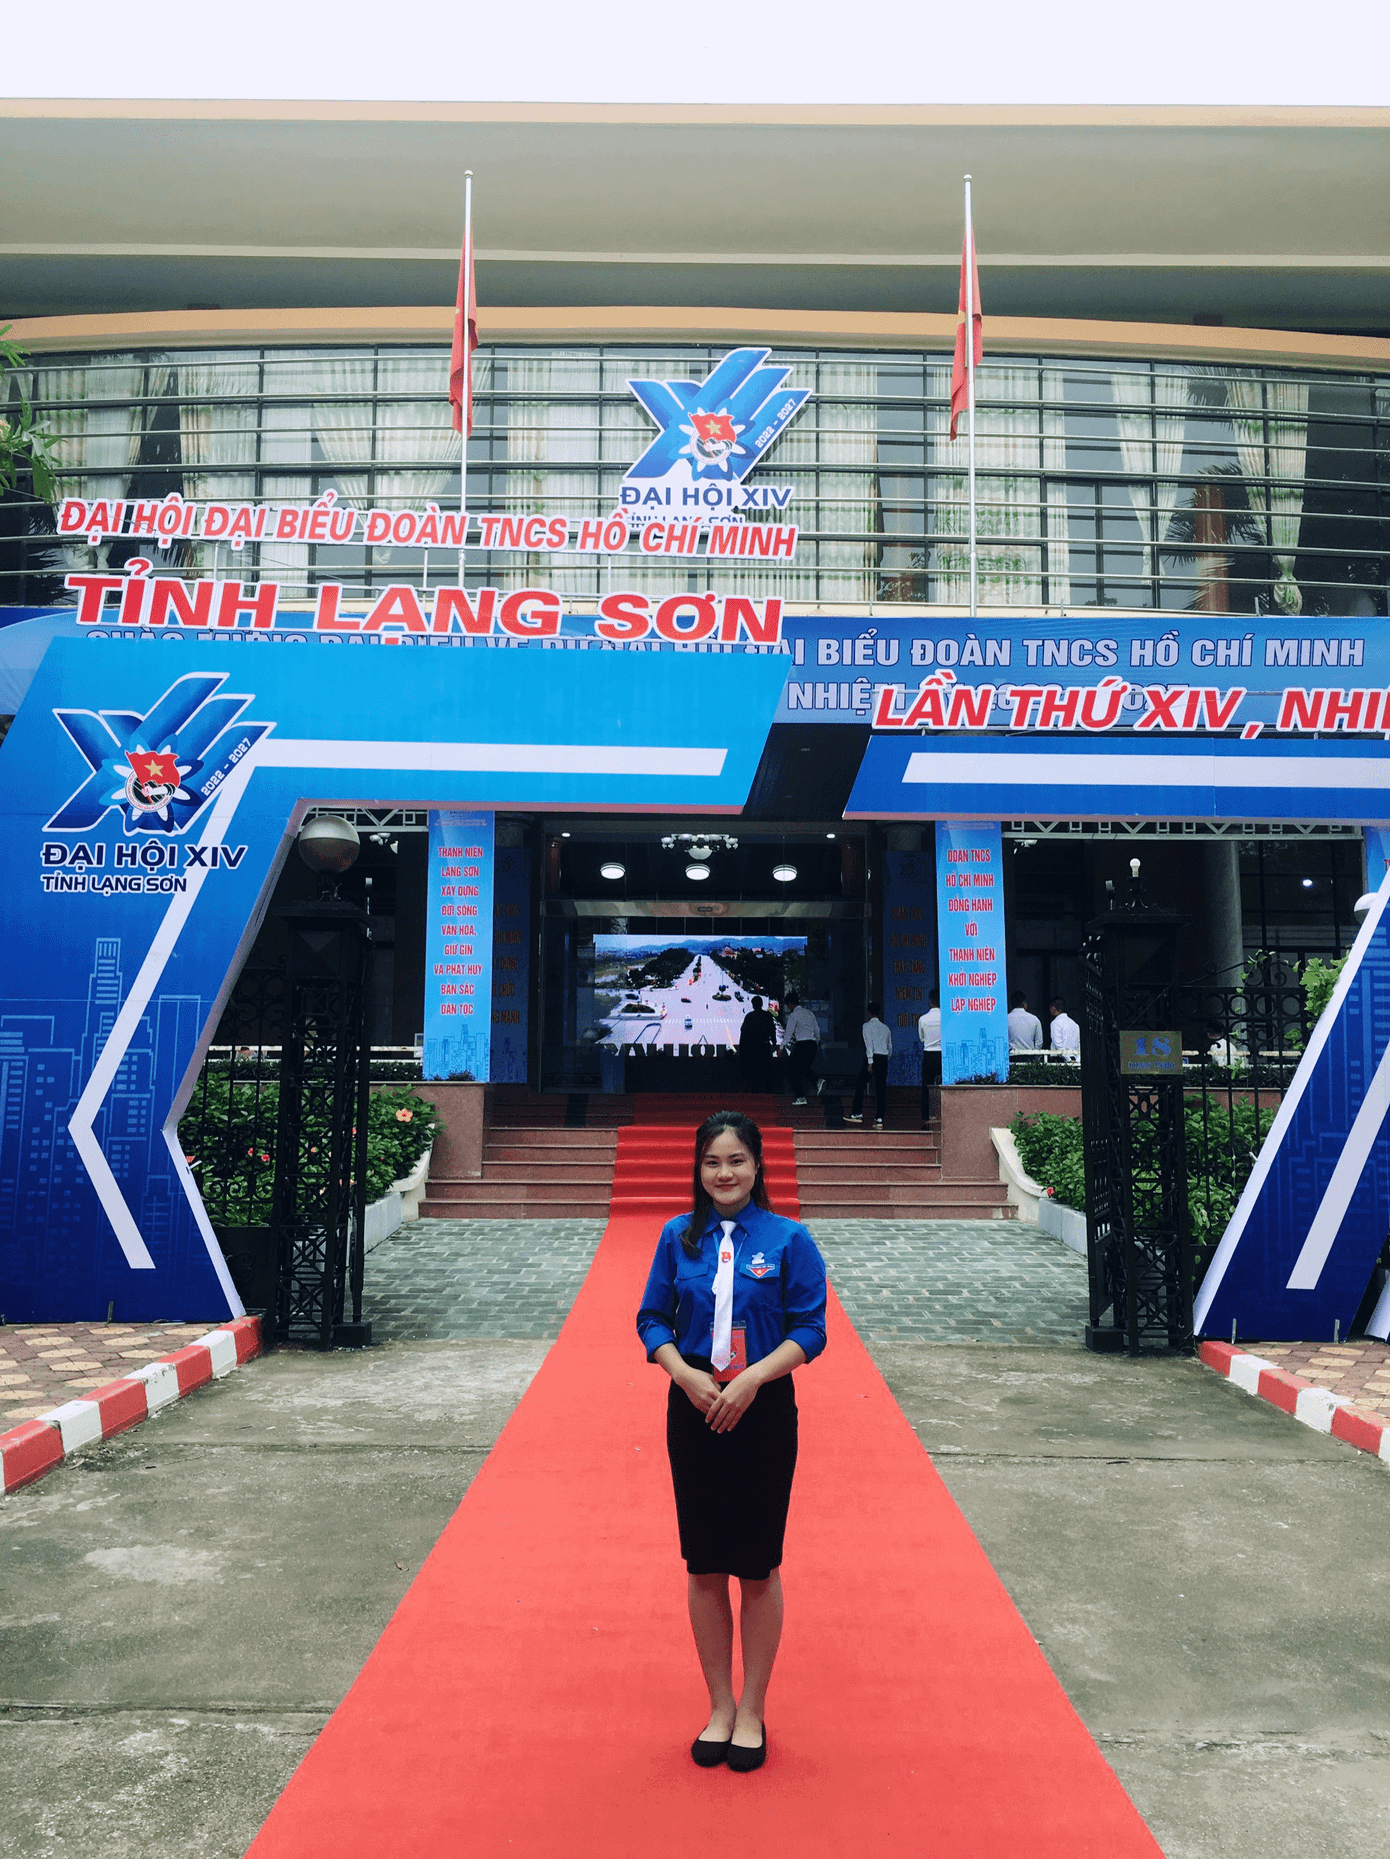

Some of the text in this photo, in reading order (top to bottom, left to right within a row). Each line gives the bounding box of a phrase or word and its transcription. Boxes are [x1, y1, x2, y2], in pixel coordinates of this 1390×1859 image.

[755, 426, 775, 449] 2022
[777, 398, 797, 422] 2027
[620, 483, 792, 510] ĐẠI HỘI XIV
[61, 490, 796, 557] ĐẠI HỘI ĐẠI BIỂU ĐOÀN TNCS HỒ CHÍ MINH
[67, 558, 784, 646] TỈNH LẠNG SƠN
[817, 628, 901, 667] BIỂU
[910, 634, 1012, 667] ĐOÀN
[1022, 639, 1119, 667] TNCS
[1130, 630, 1181, 667] HỒ
[1191, 633, 1255, 667] CHÍ
[1264, 639, 1365, 667] MINH
[875, 671, 992, 727] LẦN
[1008, 678, 1129, 729] THỨ
[200, 770, 225, 797] 2022
[229, 737, 252, 763] 2027
[42, 839, 247, 872] ĐẠI HỘI XIV
[438, 847, 463, 857] THANH
[947, 847, 990, 862] ĐOÀN TNCS
[42, 872, 187, 895] TỈNH LẠNG SƠN
[958, 871, 971, 887] CHÍ
[973, 873, 994, 887] MINH
[949, 945, 995, 961] THANH NIÊN
[467, 964, 482, 975] HUY
[969, 970, 997, 988] NGHIỆP
[951, 995, 996, 1014] LẬP NGHIỆP
[1133, 1036, 1172, 1056] 18
